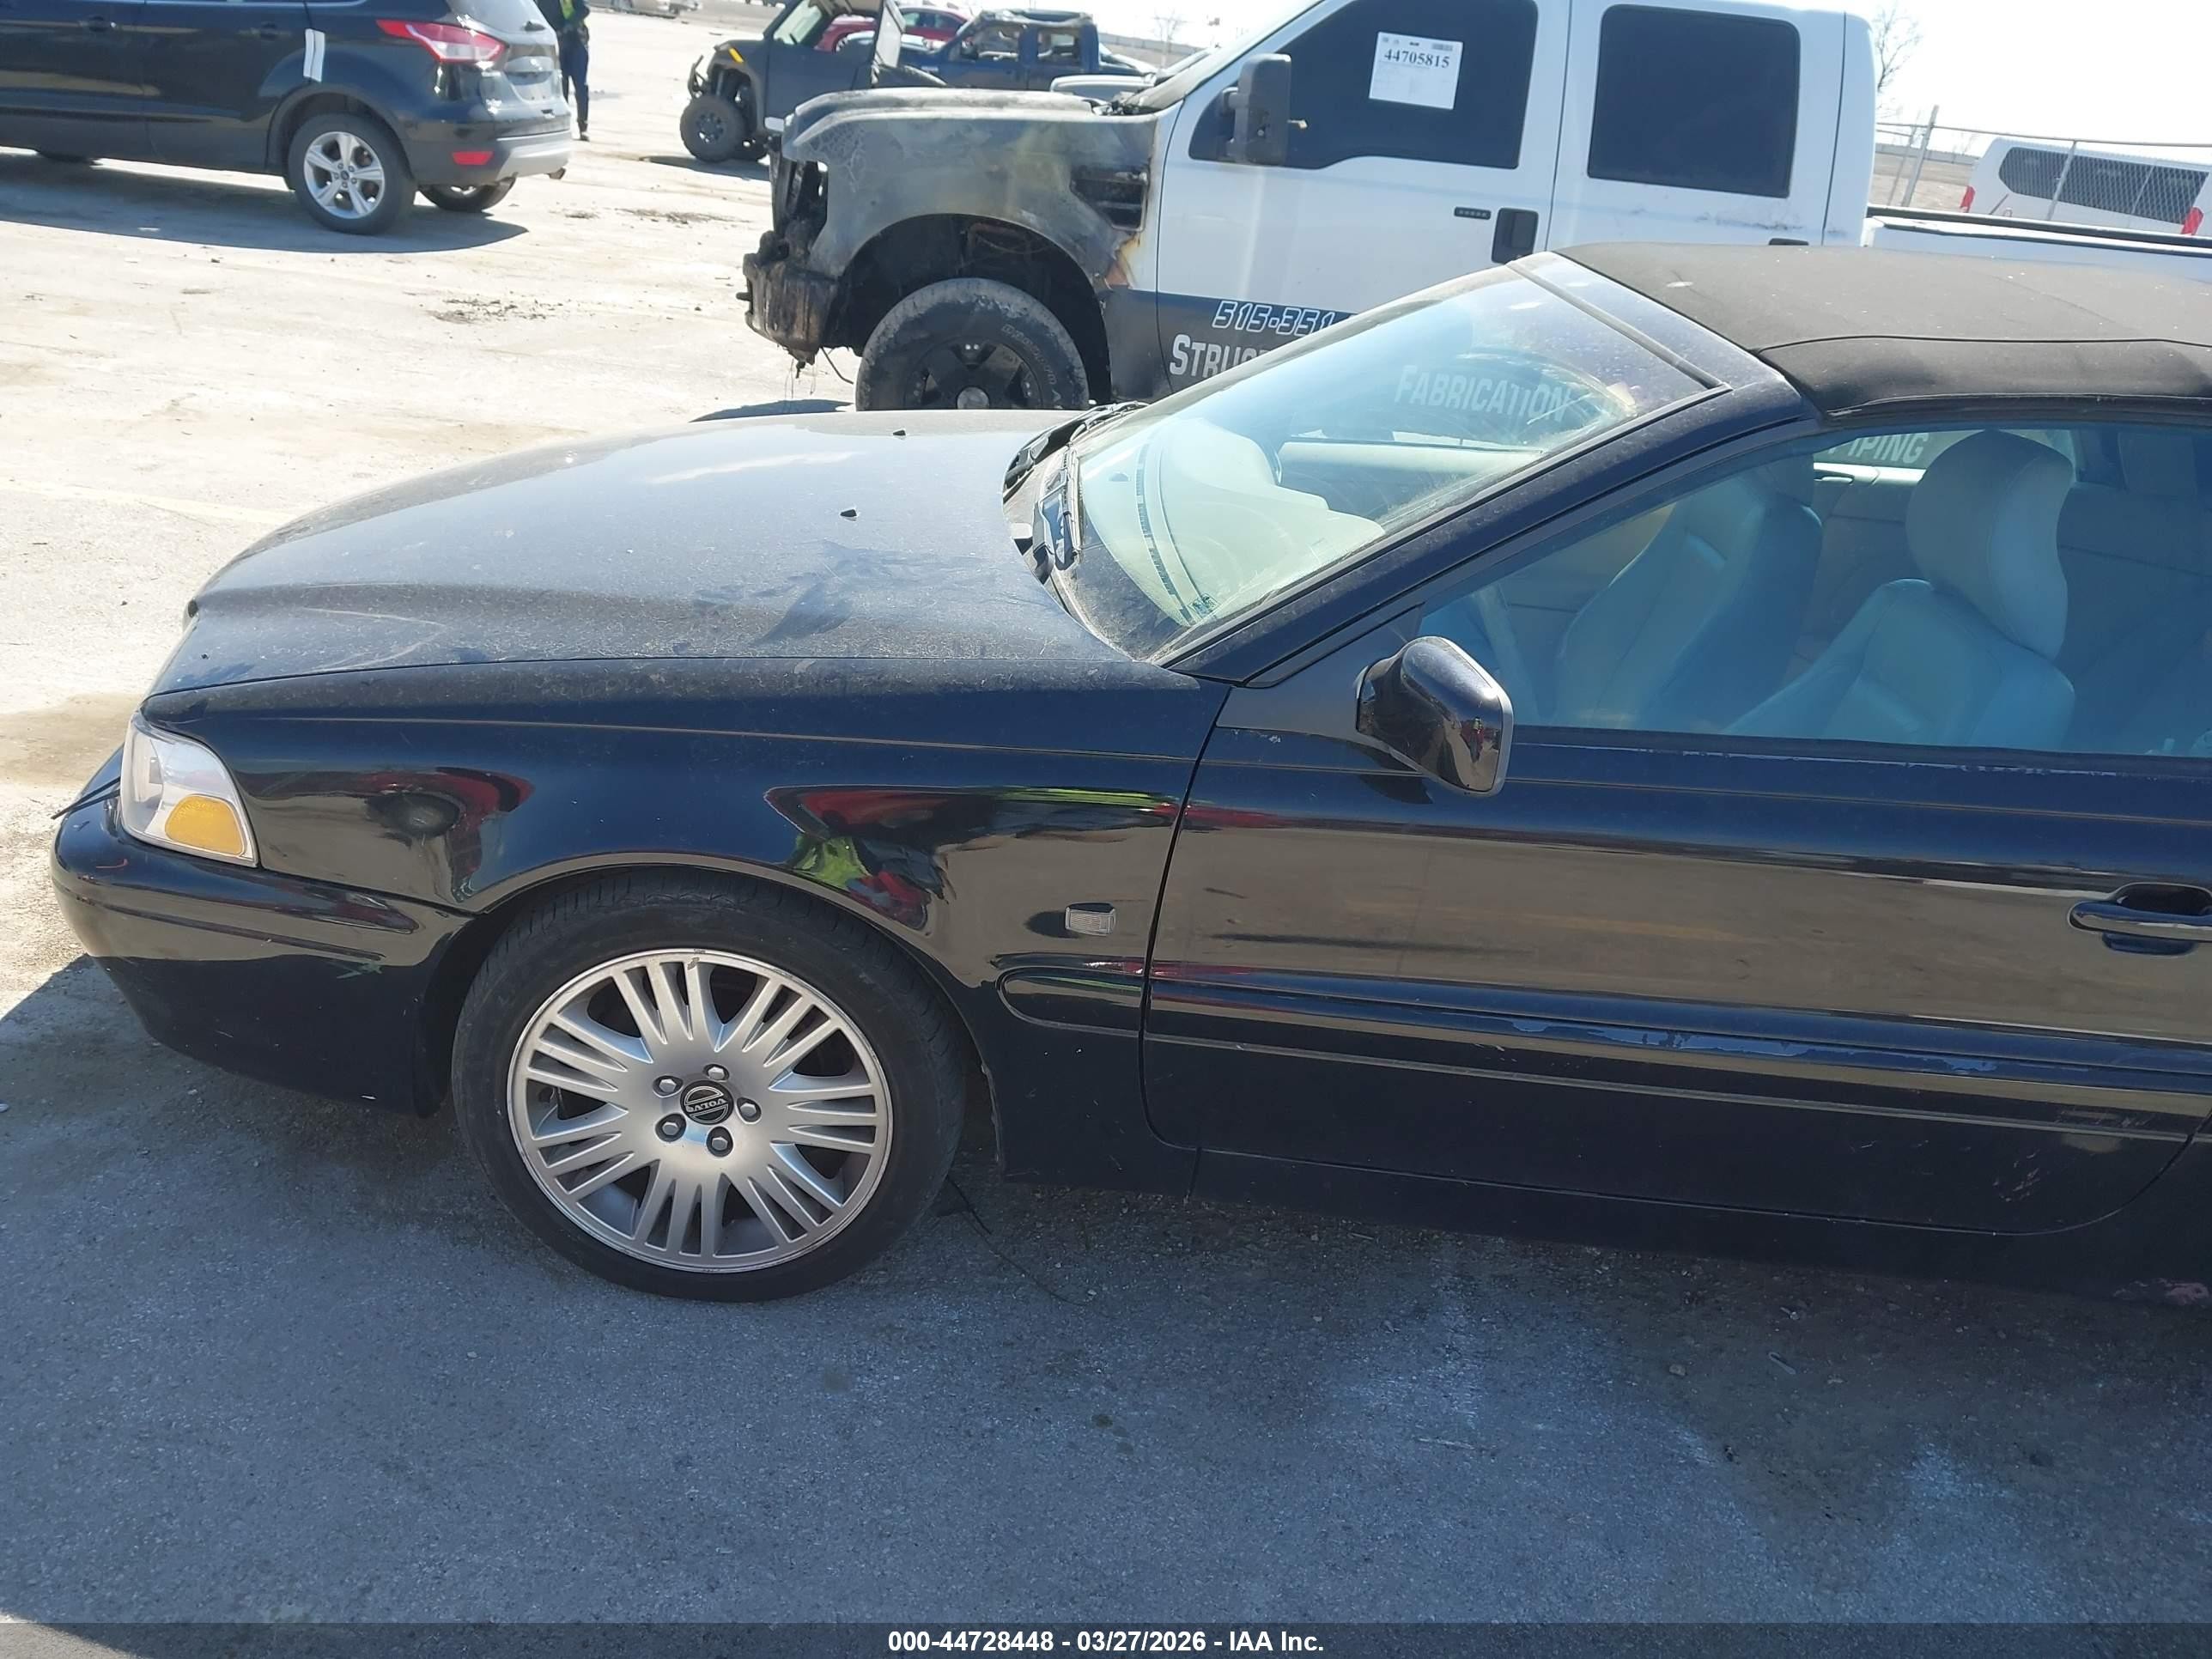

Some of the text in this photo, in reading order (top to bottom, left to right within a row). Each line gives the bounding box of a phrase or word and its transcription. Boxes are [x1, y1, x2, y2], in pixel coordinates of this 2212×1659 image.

[1383, 48, 1450, 69] 44705815
[1212, 301, 1356, 337] 515-351
[1395, 365, 1571, 422] FABRICATION
[1827, 432, 1929, 464] IPING
[686, 1097, 728, 1113] VOLVO
